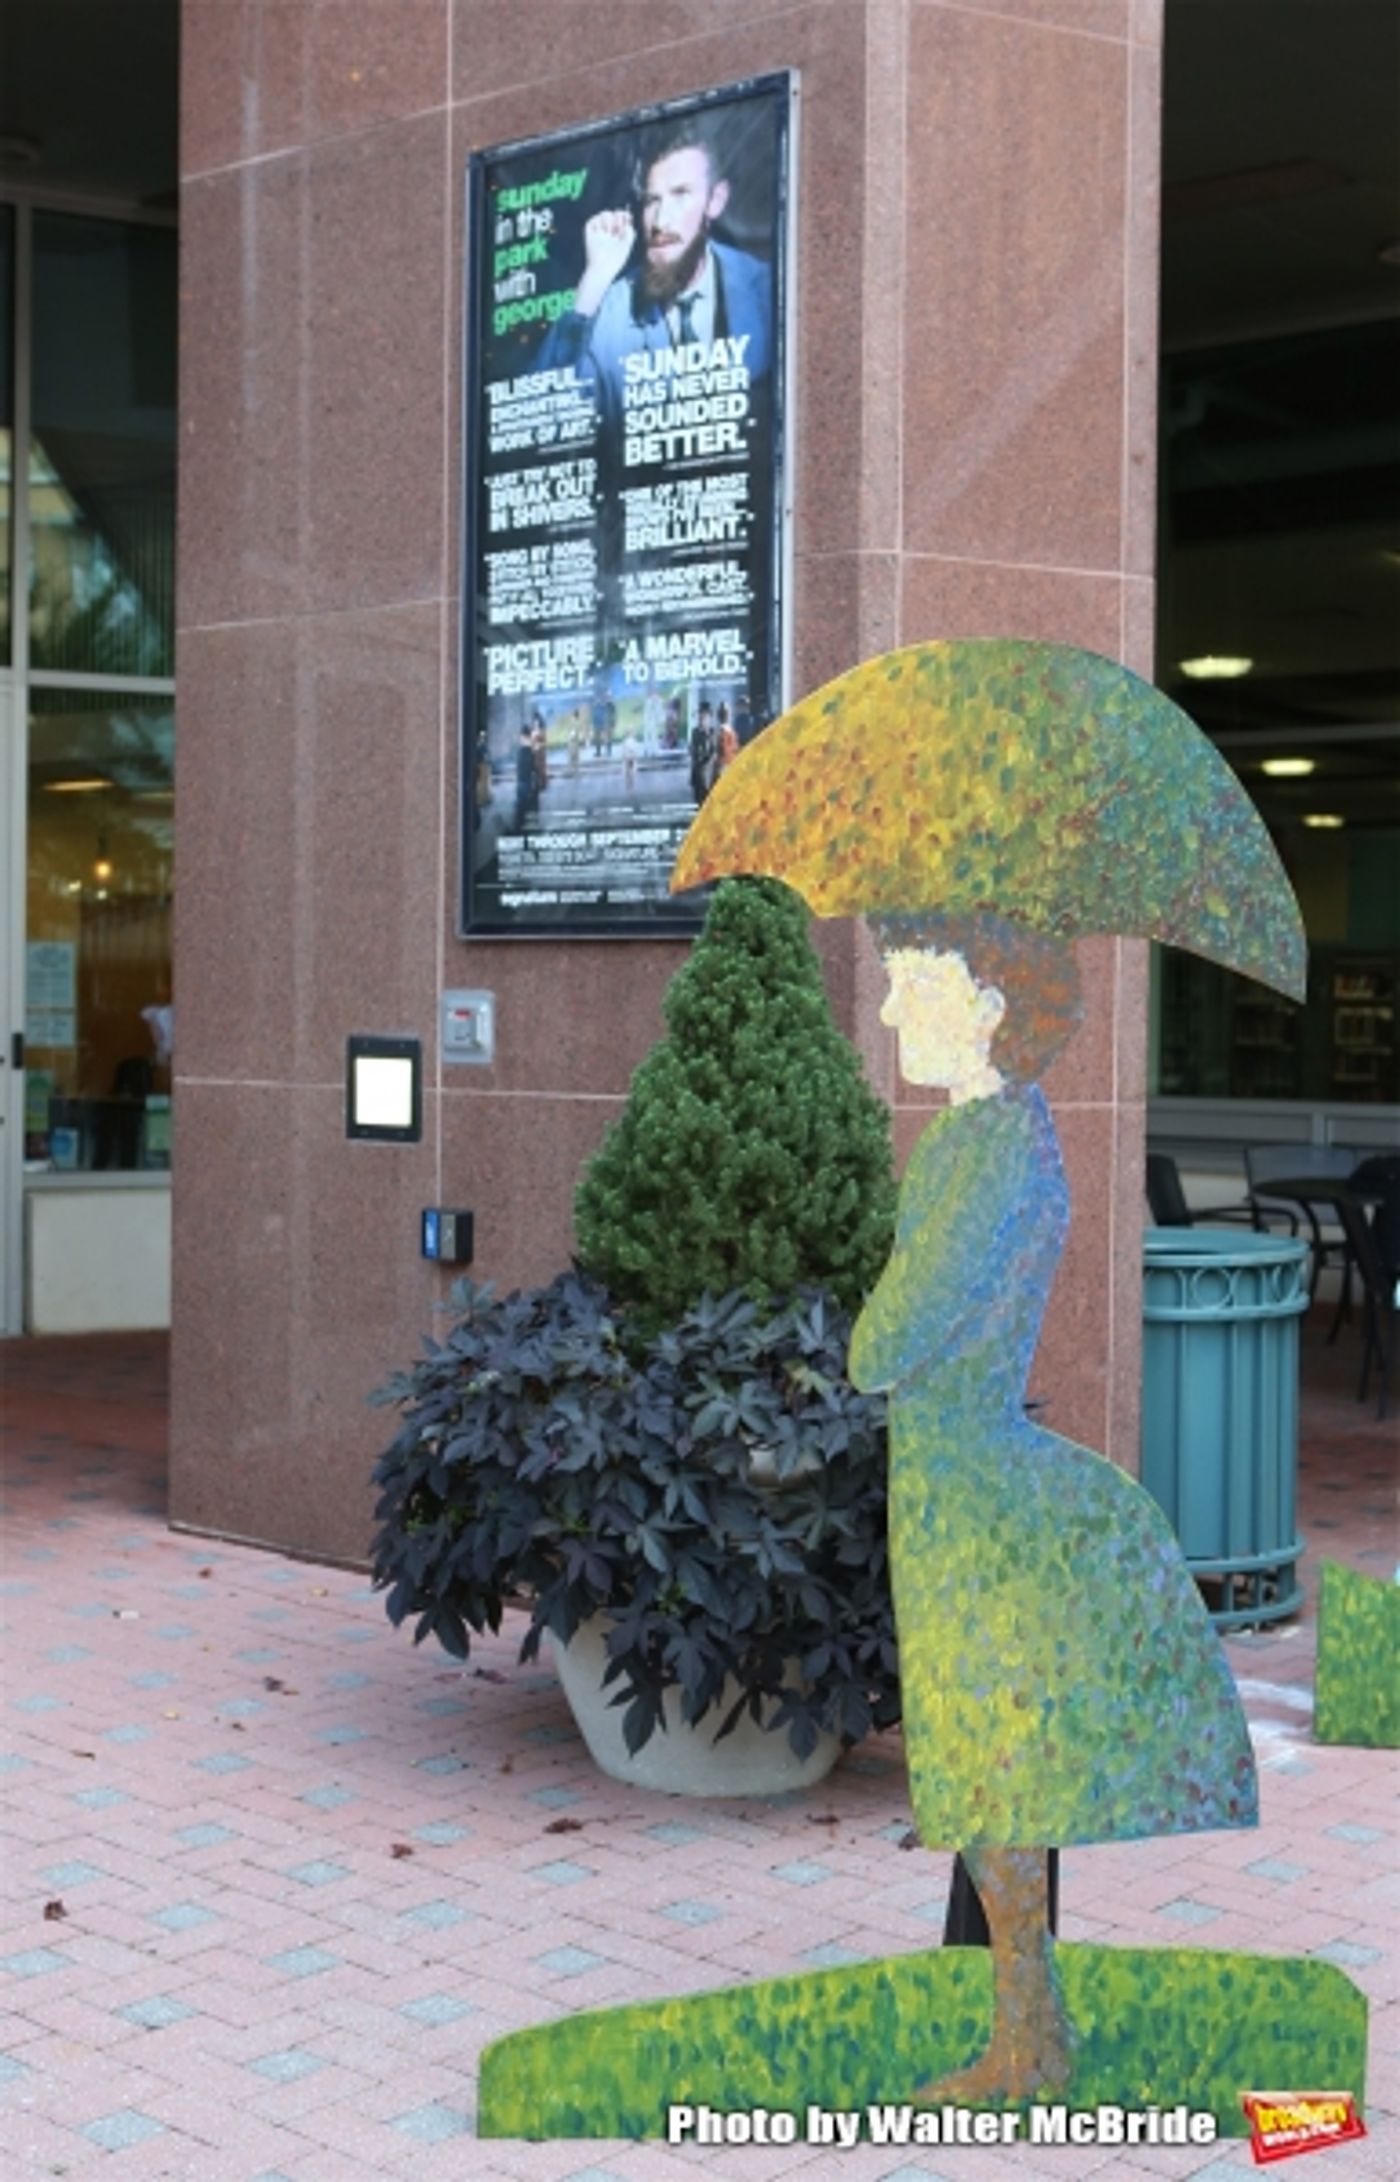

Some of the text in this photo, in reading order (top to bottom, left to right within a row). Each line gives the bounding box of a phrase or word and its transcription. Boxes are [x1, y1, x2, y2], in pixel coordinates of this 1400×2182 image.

[497, 168, 588, 212] sunday
[495, 207, 553, 245] in the
[494, 234, 548, 279] park
[493, 266, 536, 302] with
[494, 287, 577, 336] george
[624, 367, 749, 409] HAS NEVER
[625, 393, 749, 434] SOUNDED
[490, 475, 597, 511] BREAK OUT
[623, 662, 648, 684] TO
